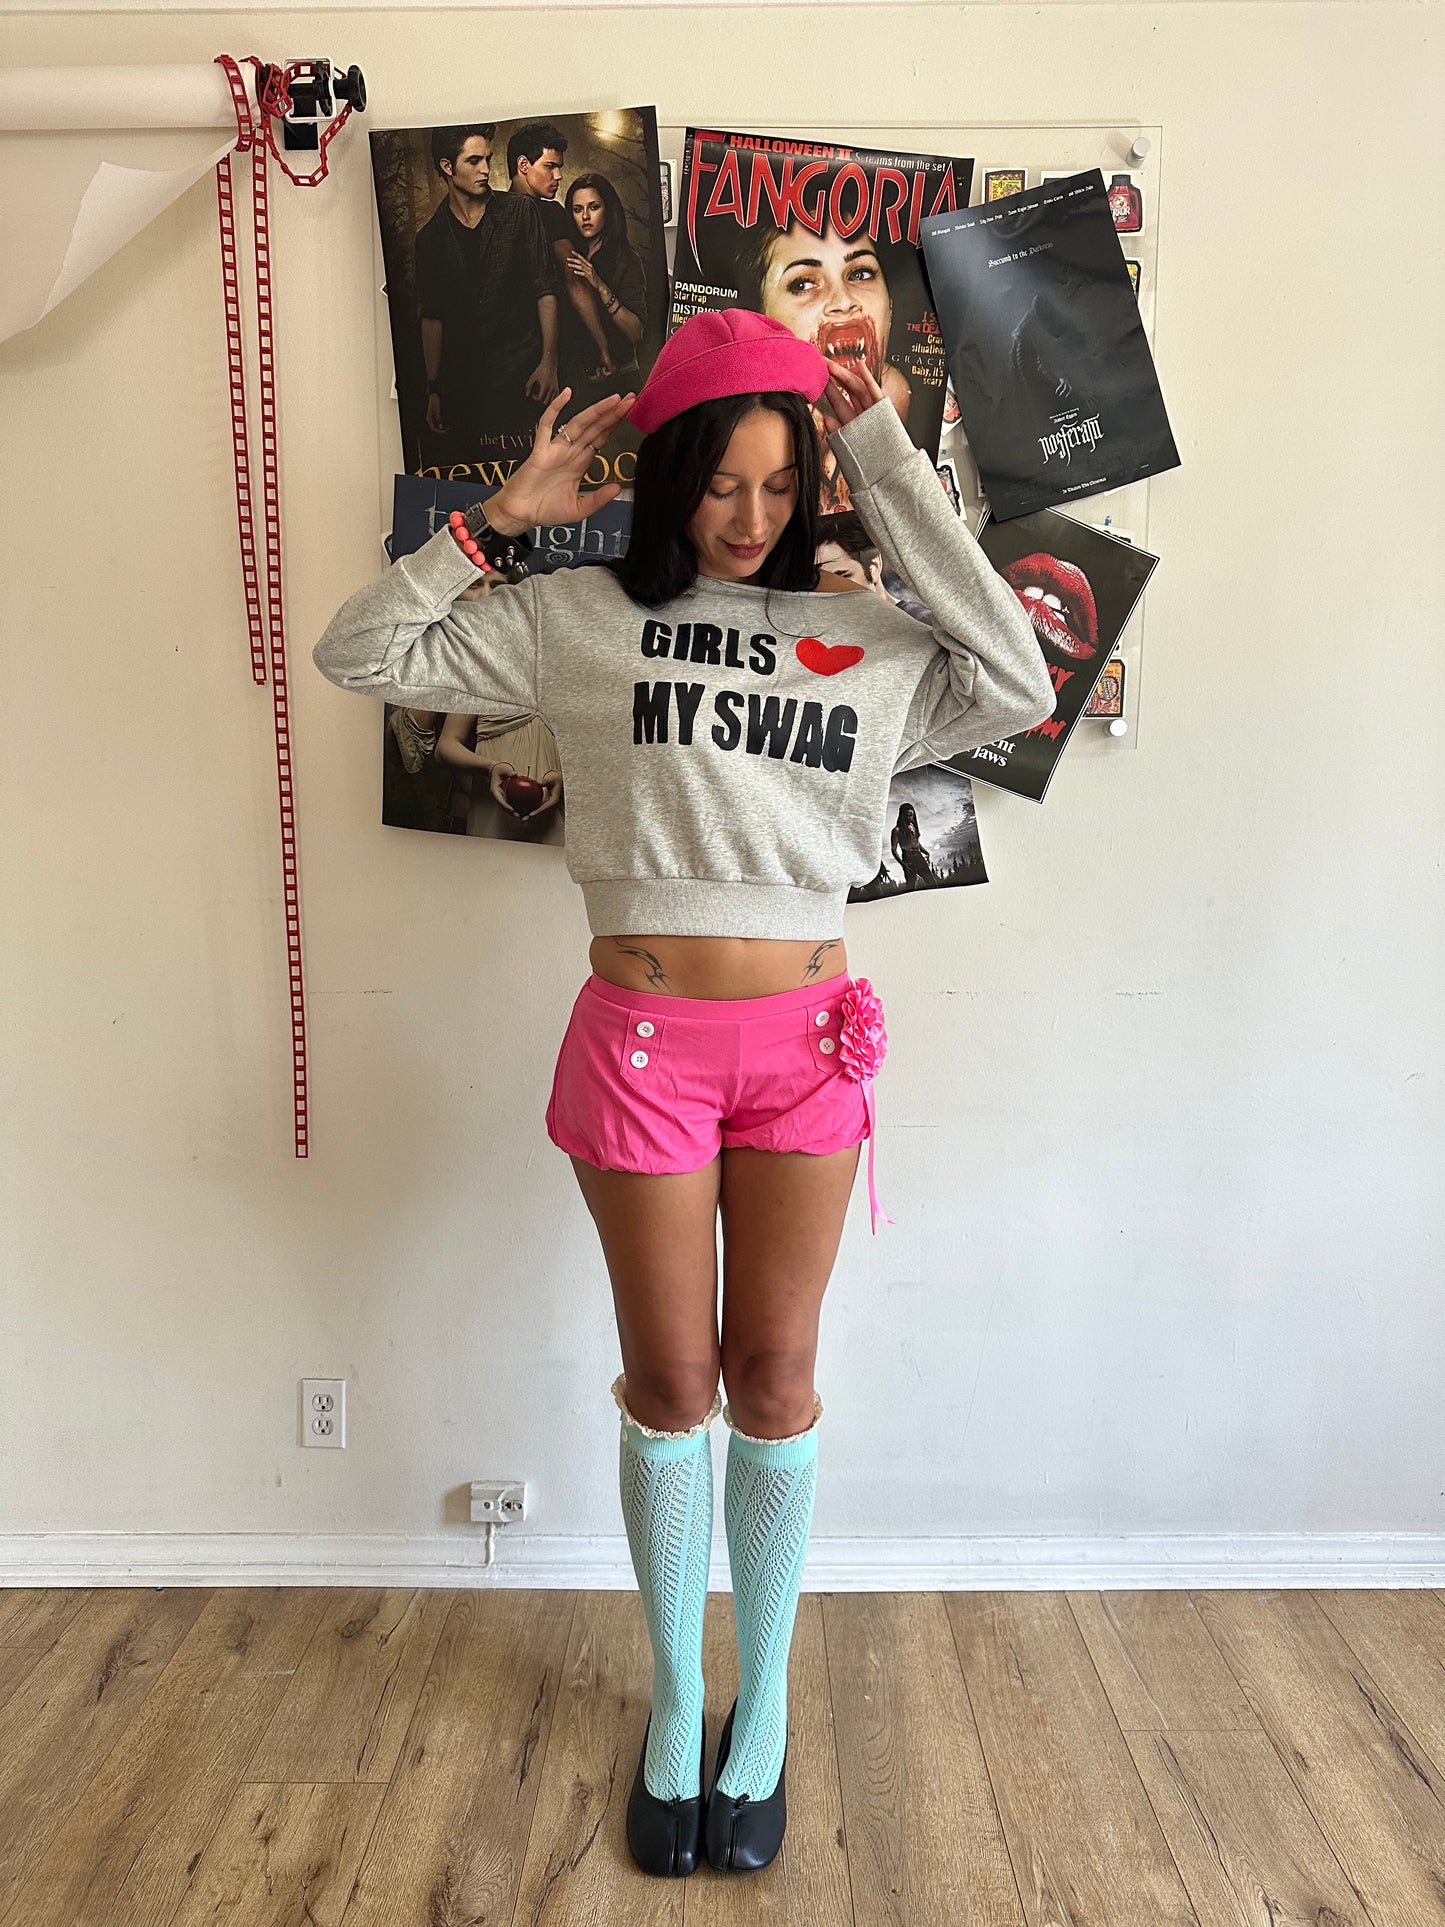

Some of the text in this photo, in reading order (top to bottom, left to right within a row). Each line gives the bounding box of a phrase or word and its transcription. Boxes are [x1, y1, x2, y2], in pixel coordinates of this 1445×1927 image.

[730, 135, 946, 173] HALLOWEEN II Screams from the set
[687, 130, 957, 276] FANGORIA
[675, 281, 738, 299] PANDORUM
[691, 292, 707, 304] trap
[911, 365, 931, 377] Baby,
[923, 378, 943, 387] scary
[480, 433, 498, 446] the
[641, 619, 777, 676] GIRLS
[632, 681, 858, 773] MY SWAG
